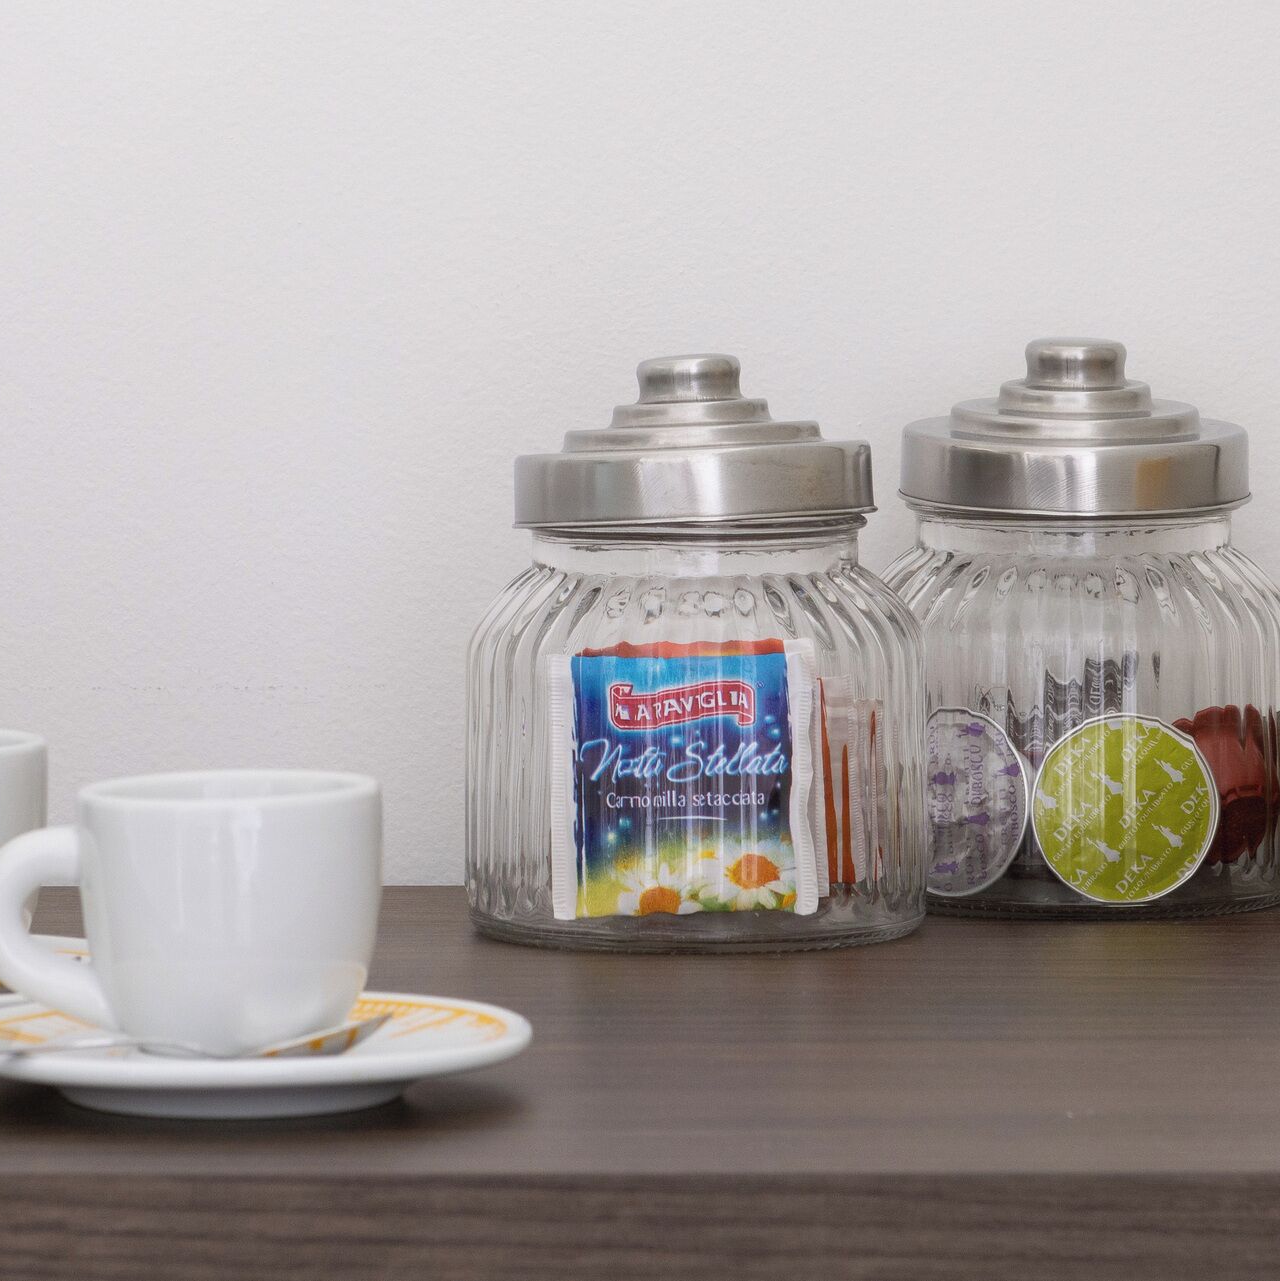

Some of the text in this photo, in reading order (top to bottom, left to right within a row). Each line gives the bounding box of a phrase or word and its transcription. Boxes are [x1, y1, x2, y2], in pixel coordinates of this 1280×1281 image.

[667, 740, 788, 783] Stellata
[1052, 798, 1092, 841] DEKA
[1117, 785, 1156, 829] DEKA
[1181, 783, 1208, 815] DEK
[1114, 850, 1153, 893] DEKA
